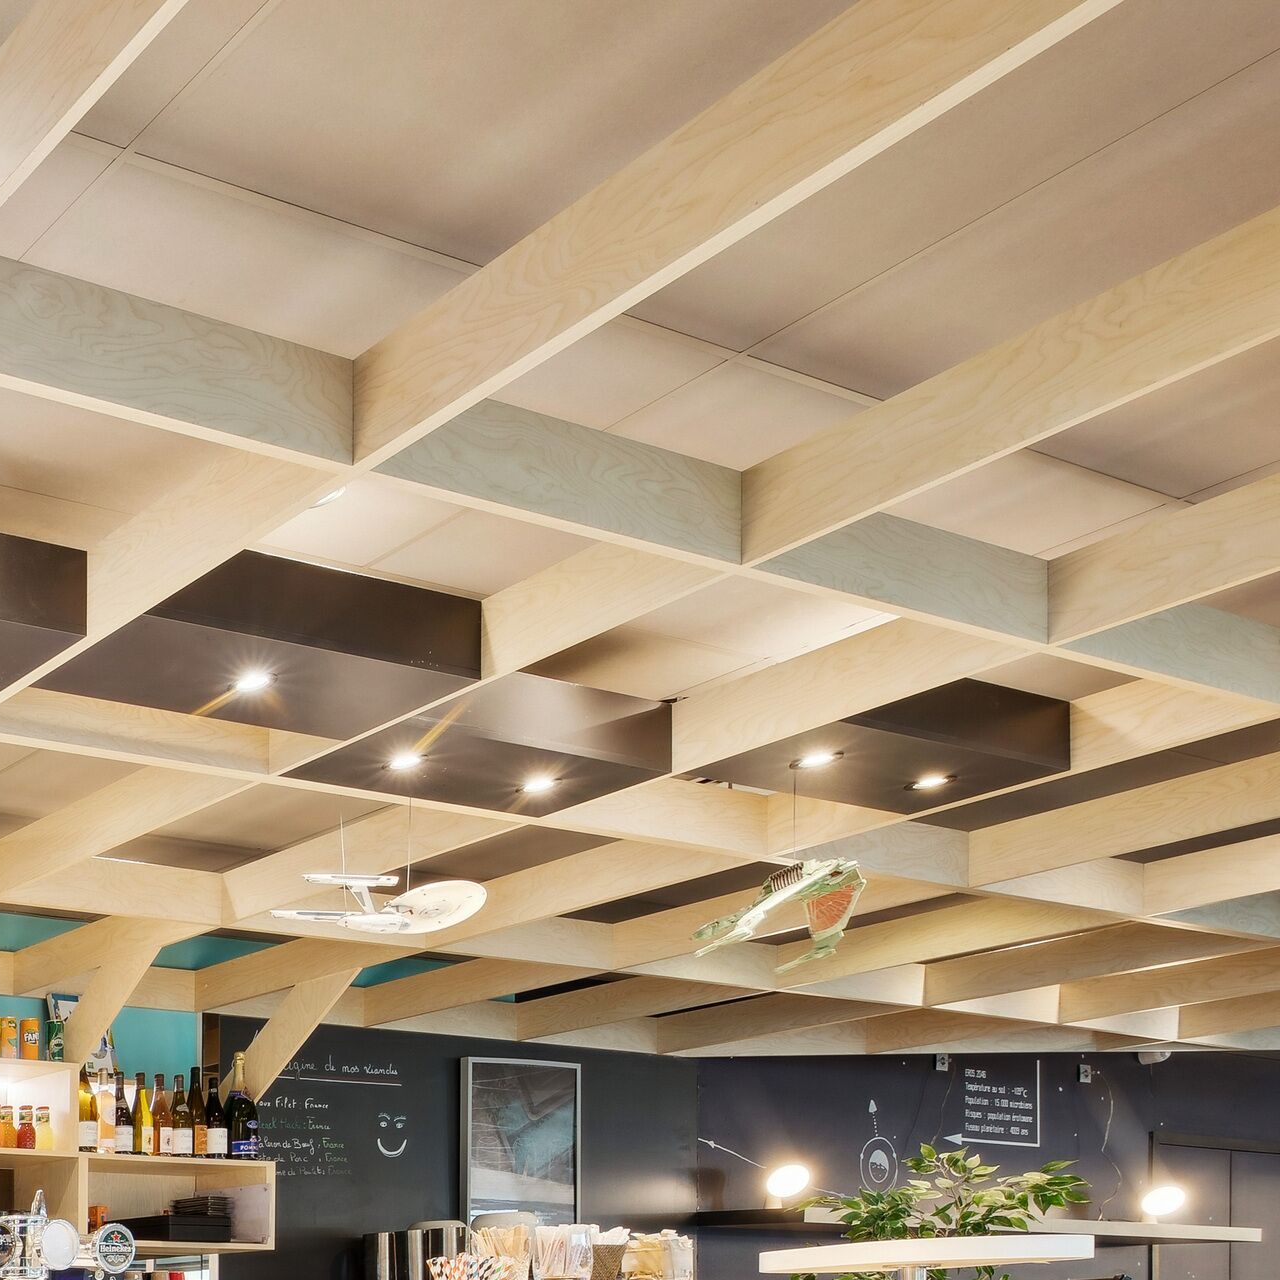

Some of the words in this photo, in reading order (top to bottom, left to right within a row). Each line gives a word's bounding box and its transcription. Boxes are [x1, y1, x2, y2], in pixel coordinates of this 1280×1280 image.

[24, 1032, 39, 1042] FAN
[324, 1054, 336, 1072] de
[276, 1096, 297, 1108] Filet
[304, 1097, 329, 1109] France
[100, 1244, 132, 1252] Heineken
